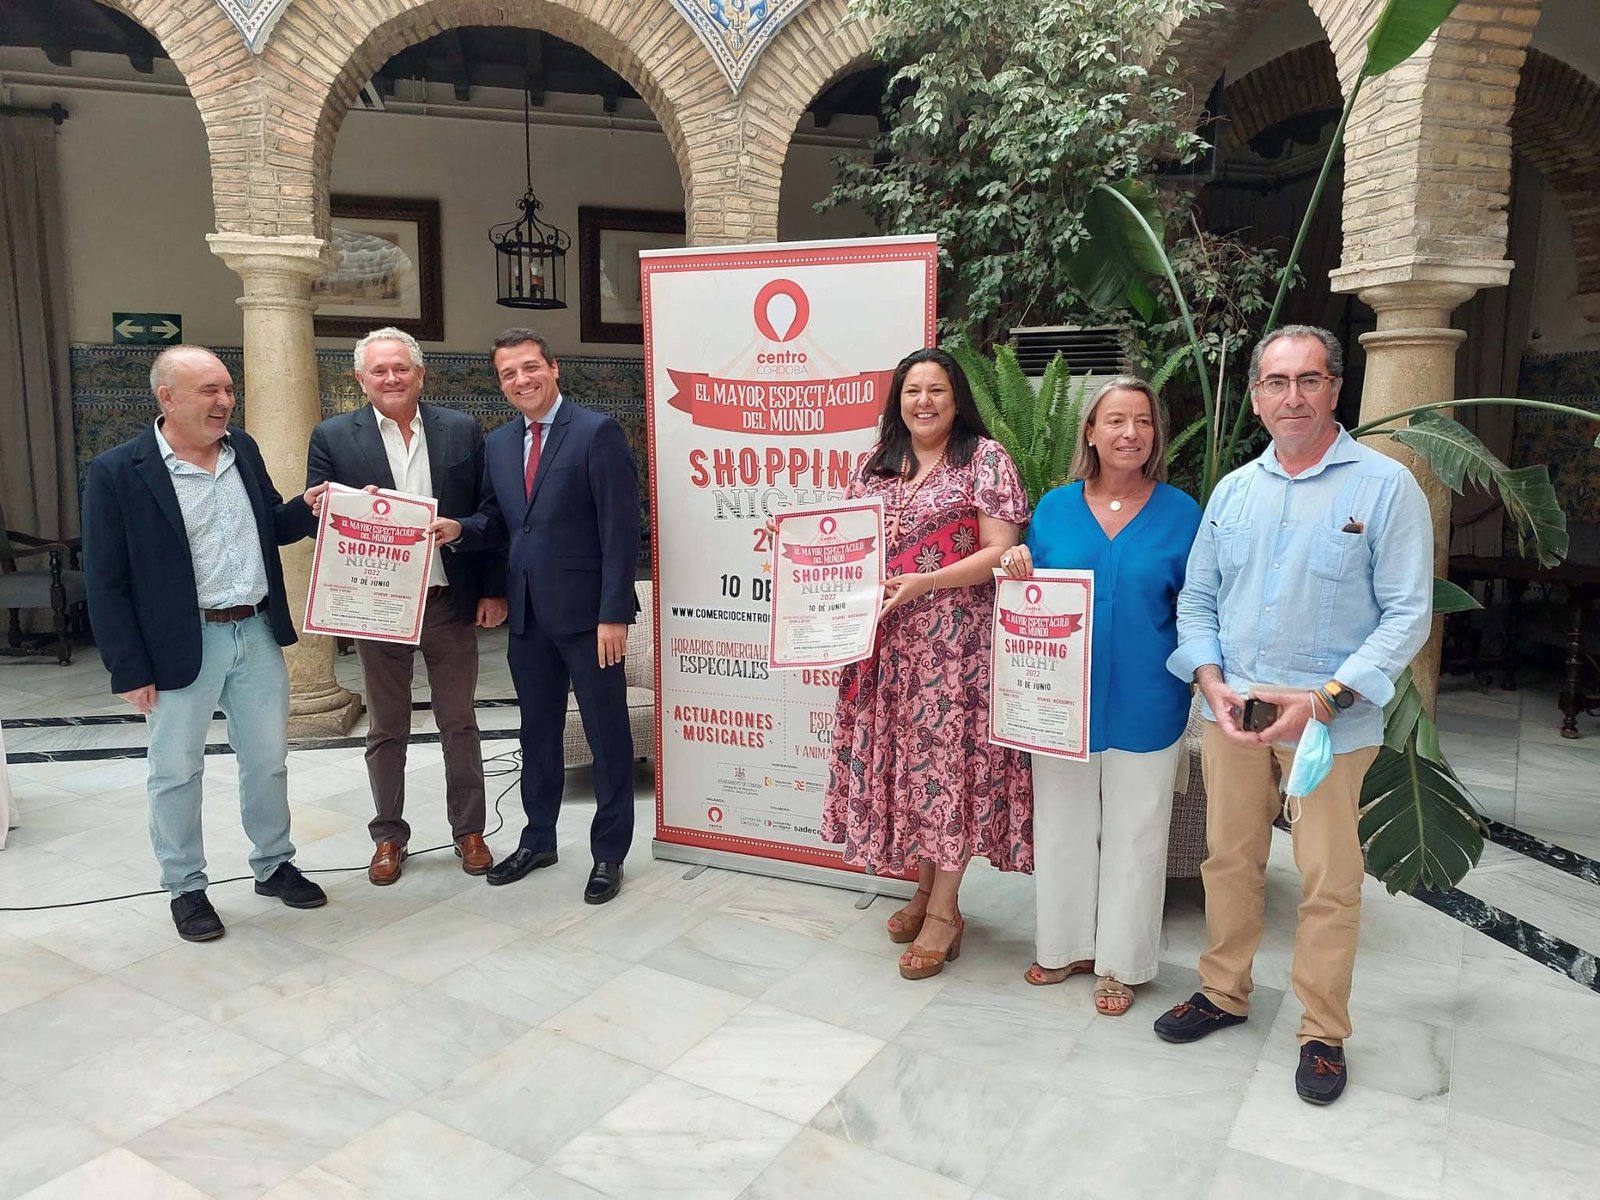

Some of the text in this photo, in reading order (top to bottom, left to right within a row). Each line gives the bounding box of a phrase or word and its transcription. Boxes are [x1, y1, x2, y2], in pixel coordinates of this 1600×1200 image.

[757, 350, 808, 364] centro
[695, 379, 874, 411] EL MAYOR ESPECTÁCULO
[742, 408, 824, 432] DEL MUNDO
[350, 521, 372, 533] MAYOR
[361, 532, 394, 543] DEL MUNDO
[338, 541, 411, 562] SHOPPING
[802, 547, 823, 557] MAYOR
[345, 555, 401, 572] NIGHT
[824, 554, 845, 564] MUNDO
[364, 569, 380, 577] 2022
[793, 565, 863, 583] SHOPPING
[360, 578, 368, 586] DE
[370, 579, 390, 587] JUNIO
[720, 574, 741, 598] 10
[801, 581, 855, 595] NIGHT
[808, 602, 846, 612] 10 DE JUNIO
[1011, 614, 1028, 627] MAYOR
[1028, 626, 1049, 637] MUNDO
[671, 637, 768, 660] HORARIOS COMERCIALE
[1005, 638, 1067, 659] SHOPPING
[680, 655, 769, 680] ESPECIALES
[1011, 655, 1059, 672] NIGHT
[802, 669, 840, 688] DESC
[1025, 669, 1041, 678] 2022
[1024, 681, 1031, 690] DE
[1033, 682, 1051, 691] JUNIO
[674, 705, 774, 731] ACTUACIONES
[683, 725, 765, 749] MUSICALES
[795, 744, 800, 756] Y
[793, 825, 822, 836] sadeco
